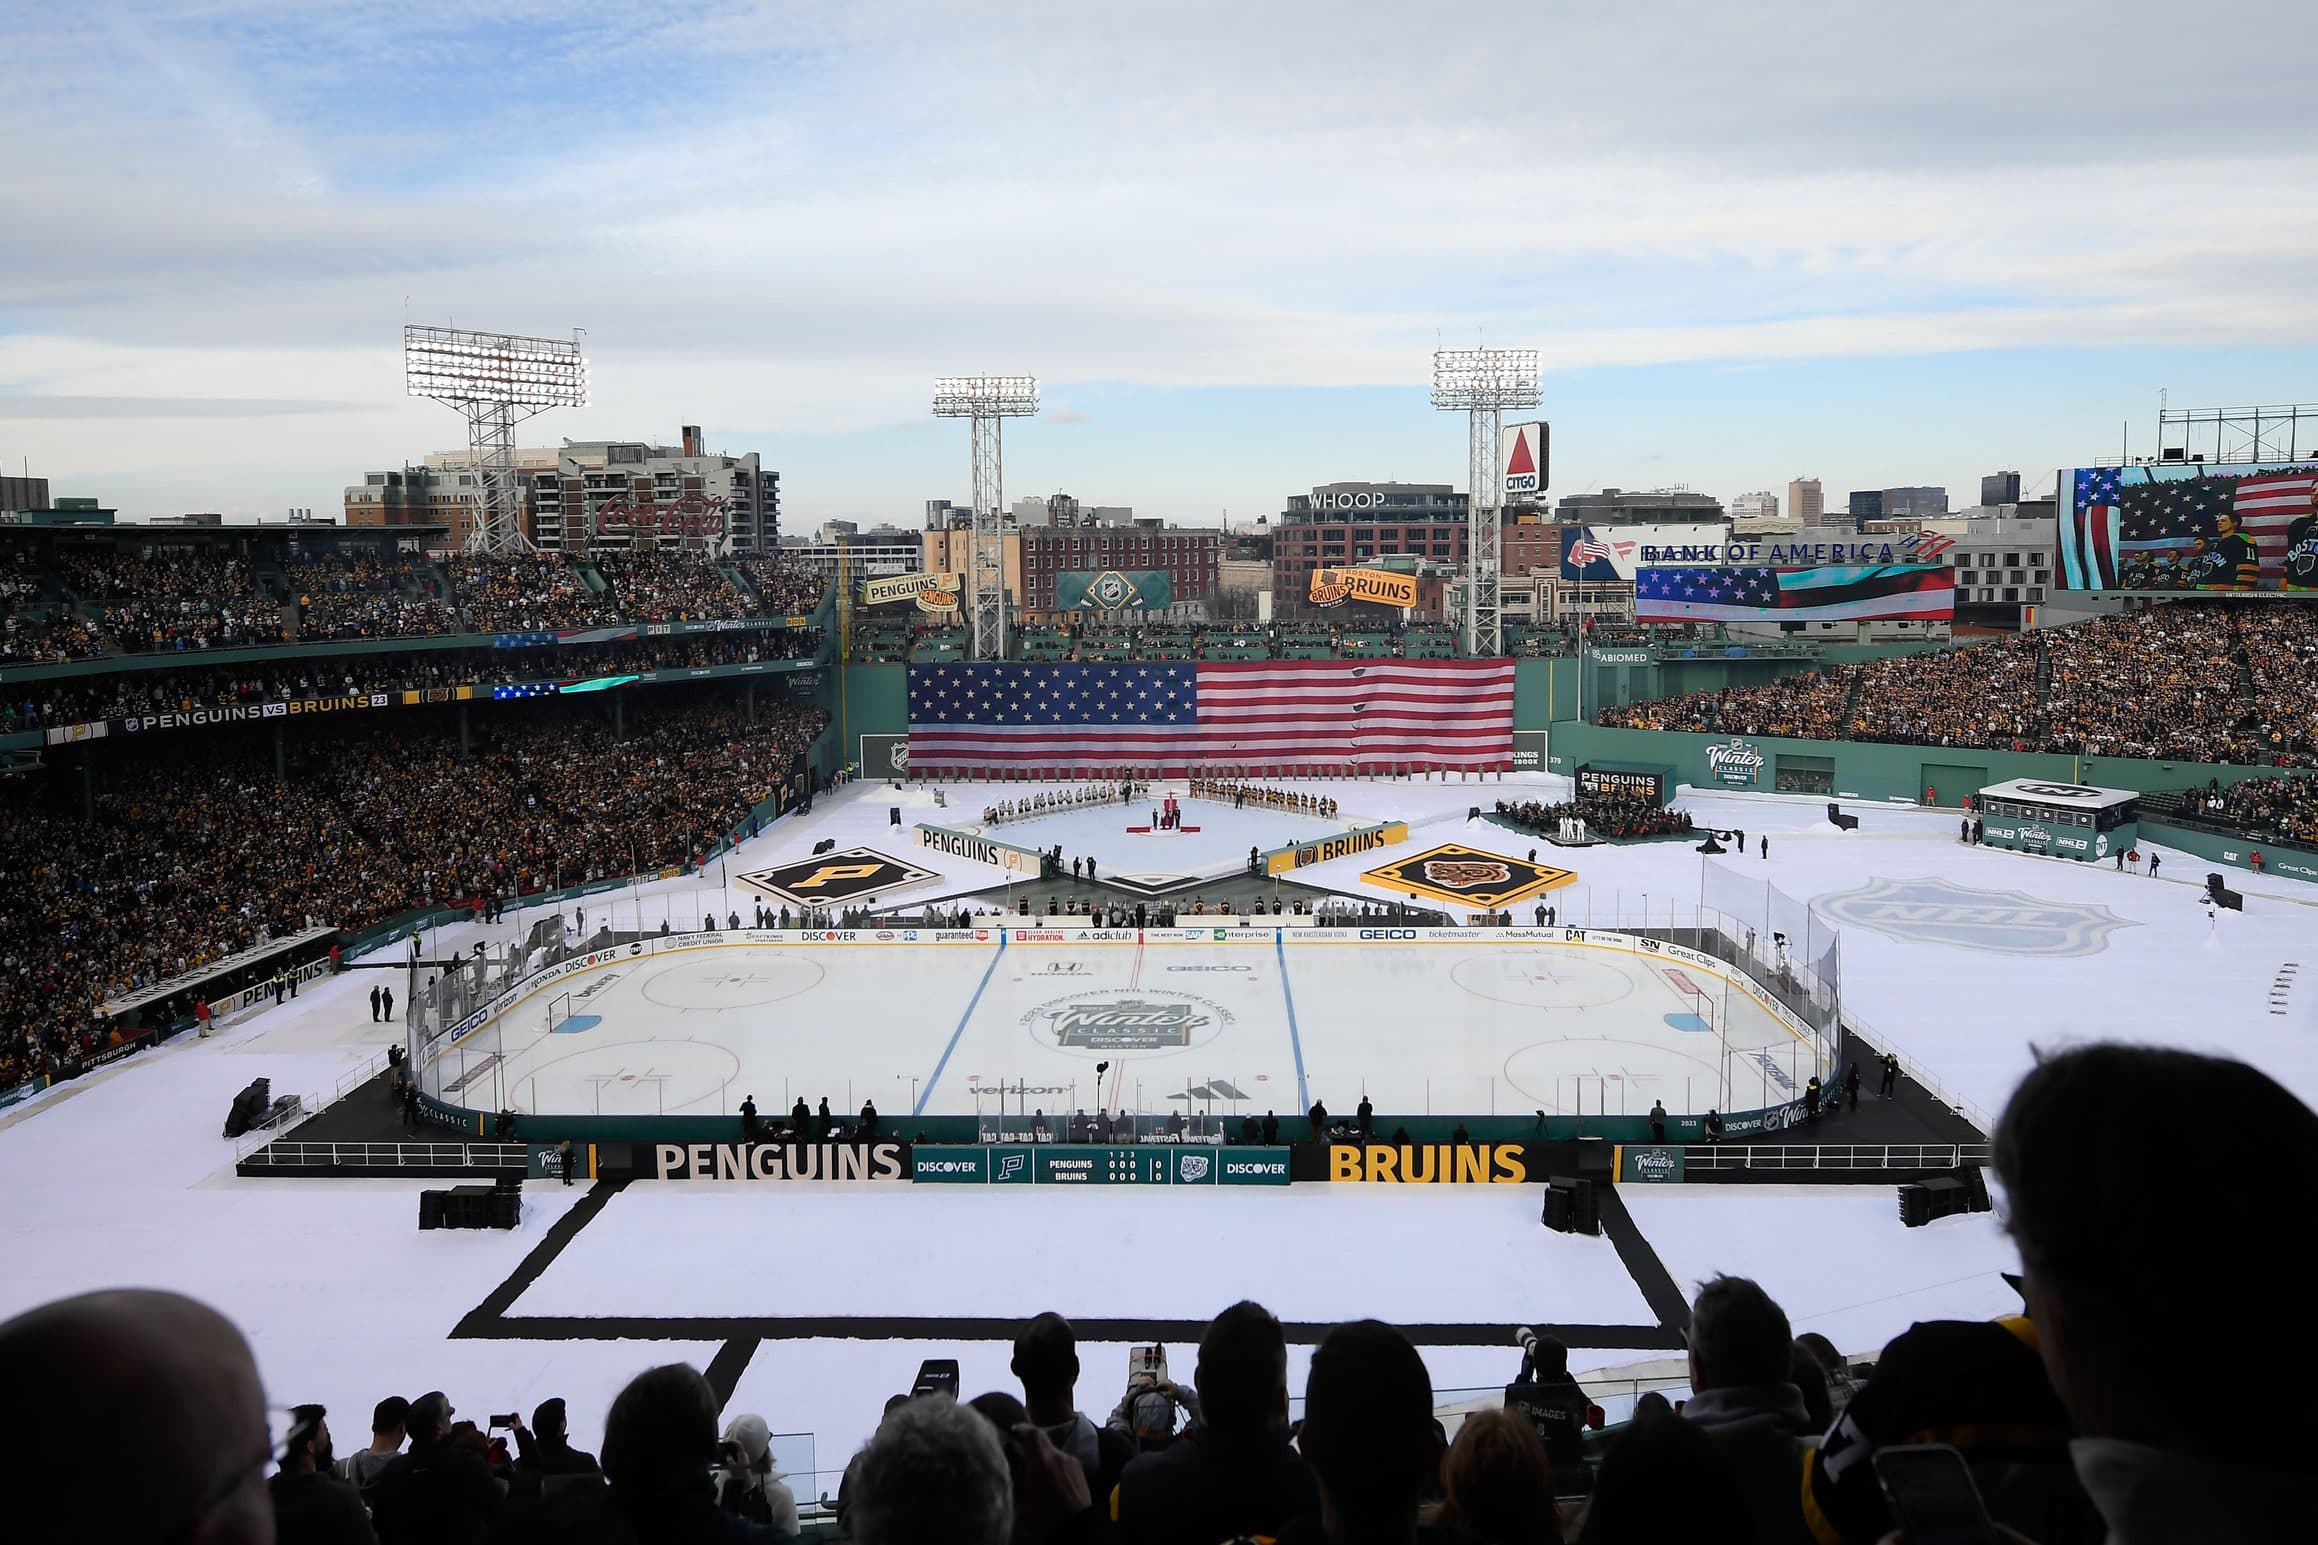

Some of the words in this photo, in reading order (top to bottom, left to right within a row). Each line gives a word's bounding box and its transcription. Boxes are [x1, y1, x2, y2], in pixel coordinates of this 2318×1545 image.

[1506, 475, 1536, 490] CITGO
[1308, 493, 1385, 510] WHOOP
[1643, 545, 1719, 562] BANK
[1728, 545, 1760, 561] OF
[1770, 543, 1893, 561] AMERICA
[2246, 546, 2256, 561] 11
[1346, 569, 1382, 579] BOSTON
[871, 578, 938, 599] PENGUINS
[1312, 585, 1346, 601] BRUINS
[1345, 576, 1412, 600] BRUINS
[920, 589, 956, 605] PENGUINS
[714, 619, 745, 632] Winter
[1601, 653, 1647, 662] ABIOMED
[143, 704, 261, 730] PENGUINS
[266, 704, 285, 715] VS
[290, 696, 369, 714] BRUINS
[373, 695, 387, 706] 23
[1706, 746, 1764, 770] Winter
[1581, 772, 1656, 786] PENGUINS
[1987, 828, 2004, 837] NHL
[2018, 827, 2052, 841] Winter
[923, 830, 998, 866] PENGUINS
[1323, 829, 1385, 861] BRUINS
[2058, 838, 2077, 848] NHL
[2224, 851, 2239, 861] CAT
[678, 934, 695, 942] NAVY
[801, 931, 856, 942] DISCOVER
[935, 930, 974, 941] guaranteed
[1092, 930, 1132, 941] adiclub
[1185, 930, 1202, 940] SAP
[1359, 929, 1417, 940] GEICO
[1429, 930, 1480, 939] ticketmaster
[1505, 930, 1554, 939] MassMutual
[1565, 929, 1587, 942] CAT
[678, 939, 701, 948] CREDIT
[702, 937, 724, 945] UNION
[1640, 938, 1661, 949] SN
[565, 949, 616, 973] DISCOVER
[1668, 945, 1695, 960] Great
[1696, 954, 1716, 970] Clips
[531, 969, 561, 989] HONDA
[1149, 988, 1203, 1001] WINTER
[451, 1009, 488, 1042] GEICO
[1041, 1008, 1211, 1035] Winter
[81, 1041, 137, 1069] PITTSBURGH
[969, 1086, 1064, 1095] verizon
[428, 1108, 469, 1128] CLASSIC
[1681, 1119, 1697, 1127] 2023
[1725, 1119, 1762, 1132] DISCOVER
[656, 1143, 902, 1181] PENGUINS
[917, 1160, 977, 1173] DISCOVER
[1049, 1159, 1093, 1169] PENGUINS
[1109, 1160, 1116, 1169] 0
[1119, 1160, 1126, 1169] 0
[1129, 1160, 1136, 1169] 0
[1155, 1160, 1162, 1169] 0
[1226, 1162, 1285, 1175] DISCOVER
[1329, 1144, 1526, 1184] BRUINS
[1635, 1154, 1676, 1172] Winter
[1055, 1172, 1088, 1181] BRUINS
[1109, 1172, 1116, 1181] 0
[1119, 1172, 1126, 1181] 0
[1129, 1172, 1136, 1181] 0
[1155, 1172, 1162, 1181] 0
[1531, 1406, 1567, 1420] IMAGES
